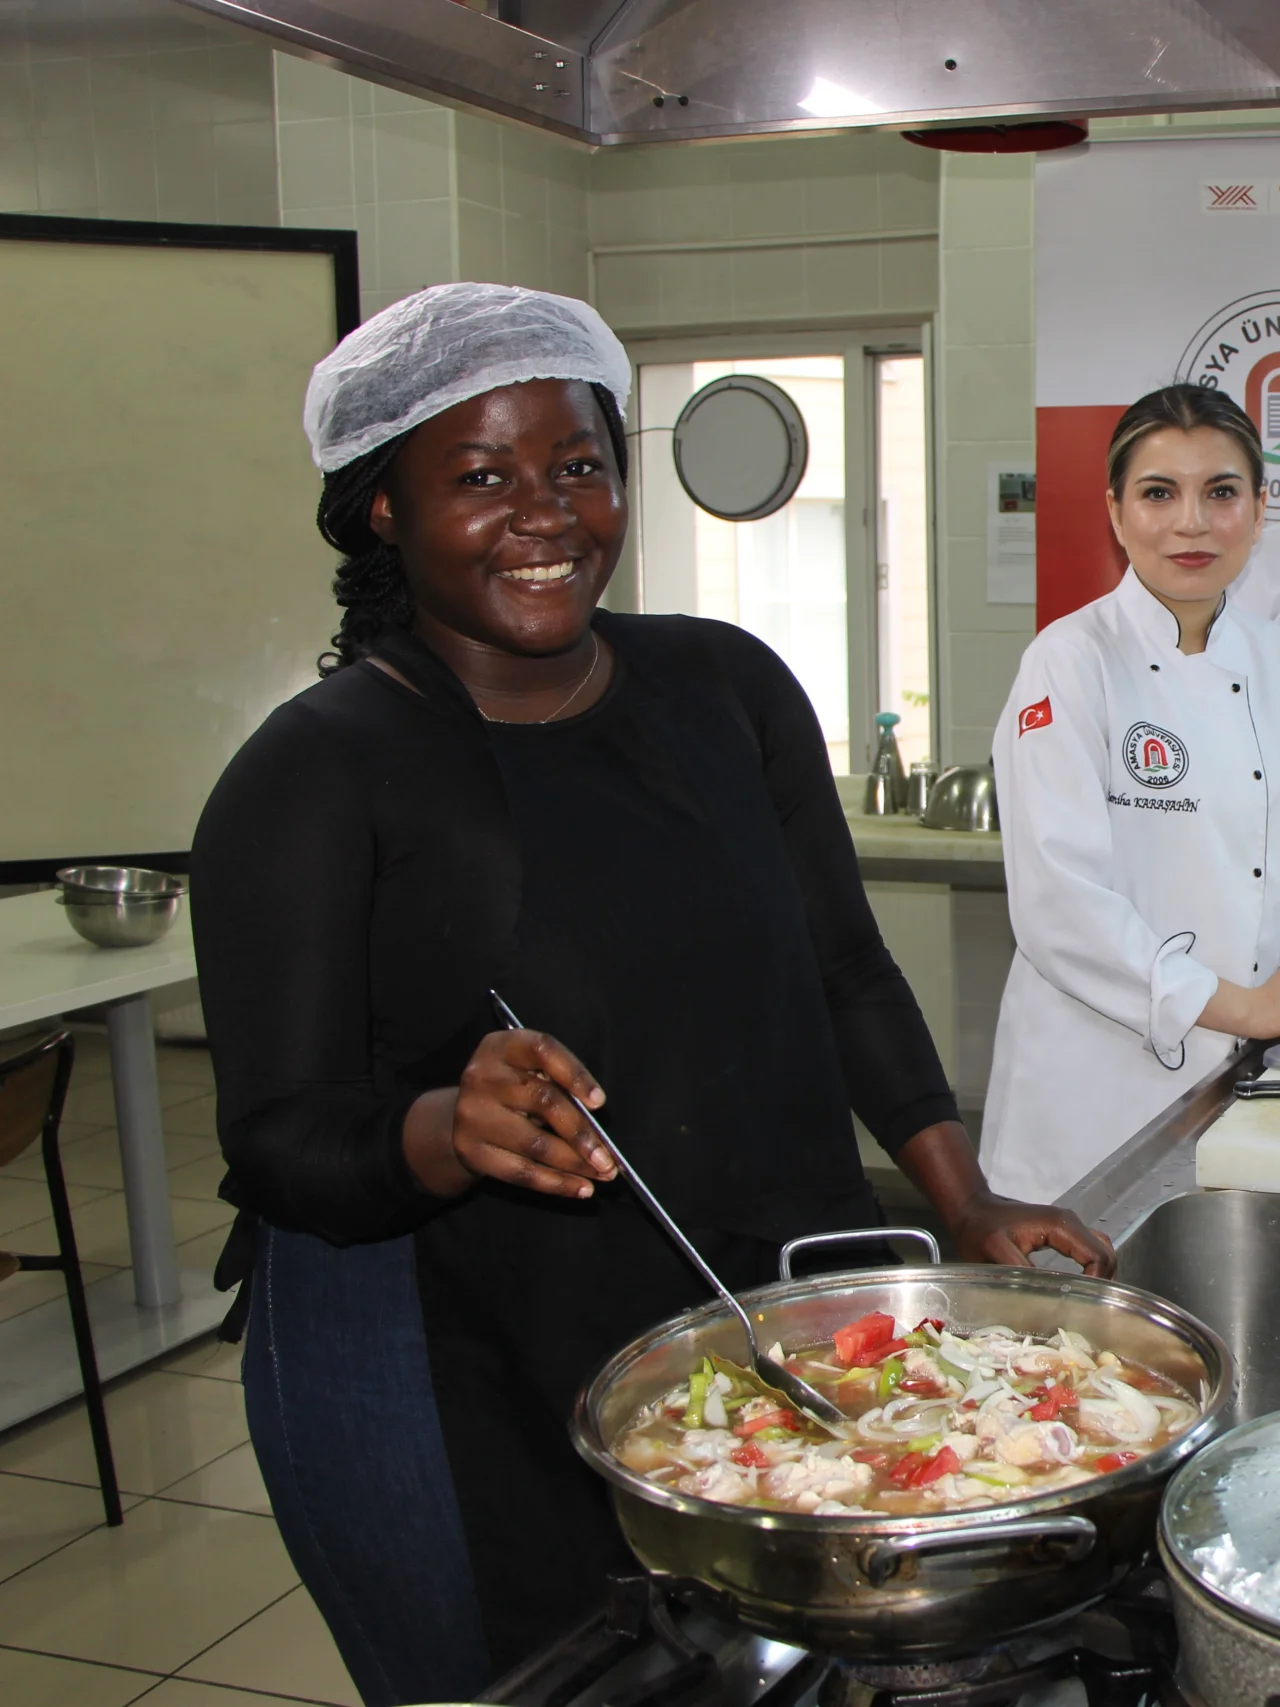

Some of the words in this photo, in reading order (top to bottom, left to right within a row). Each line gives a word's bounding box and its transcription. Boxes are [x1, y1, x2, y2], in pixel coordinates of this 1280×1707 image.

[1199, 343, 1239, 391] SYA
[1129, 732, 1143, 770] AMASYA
[1147, 775, 1170, 785] 2006
